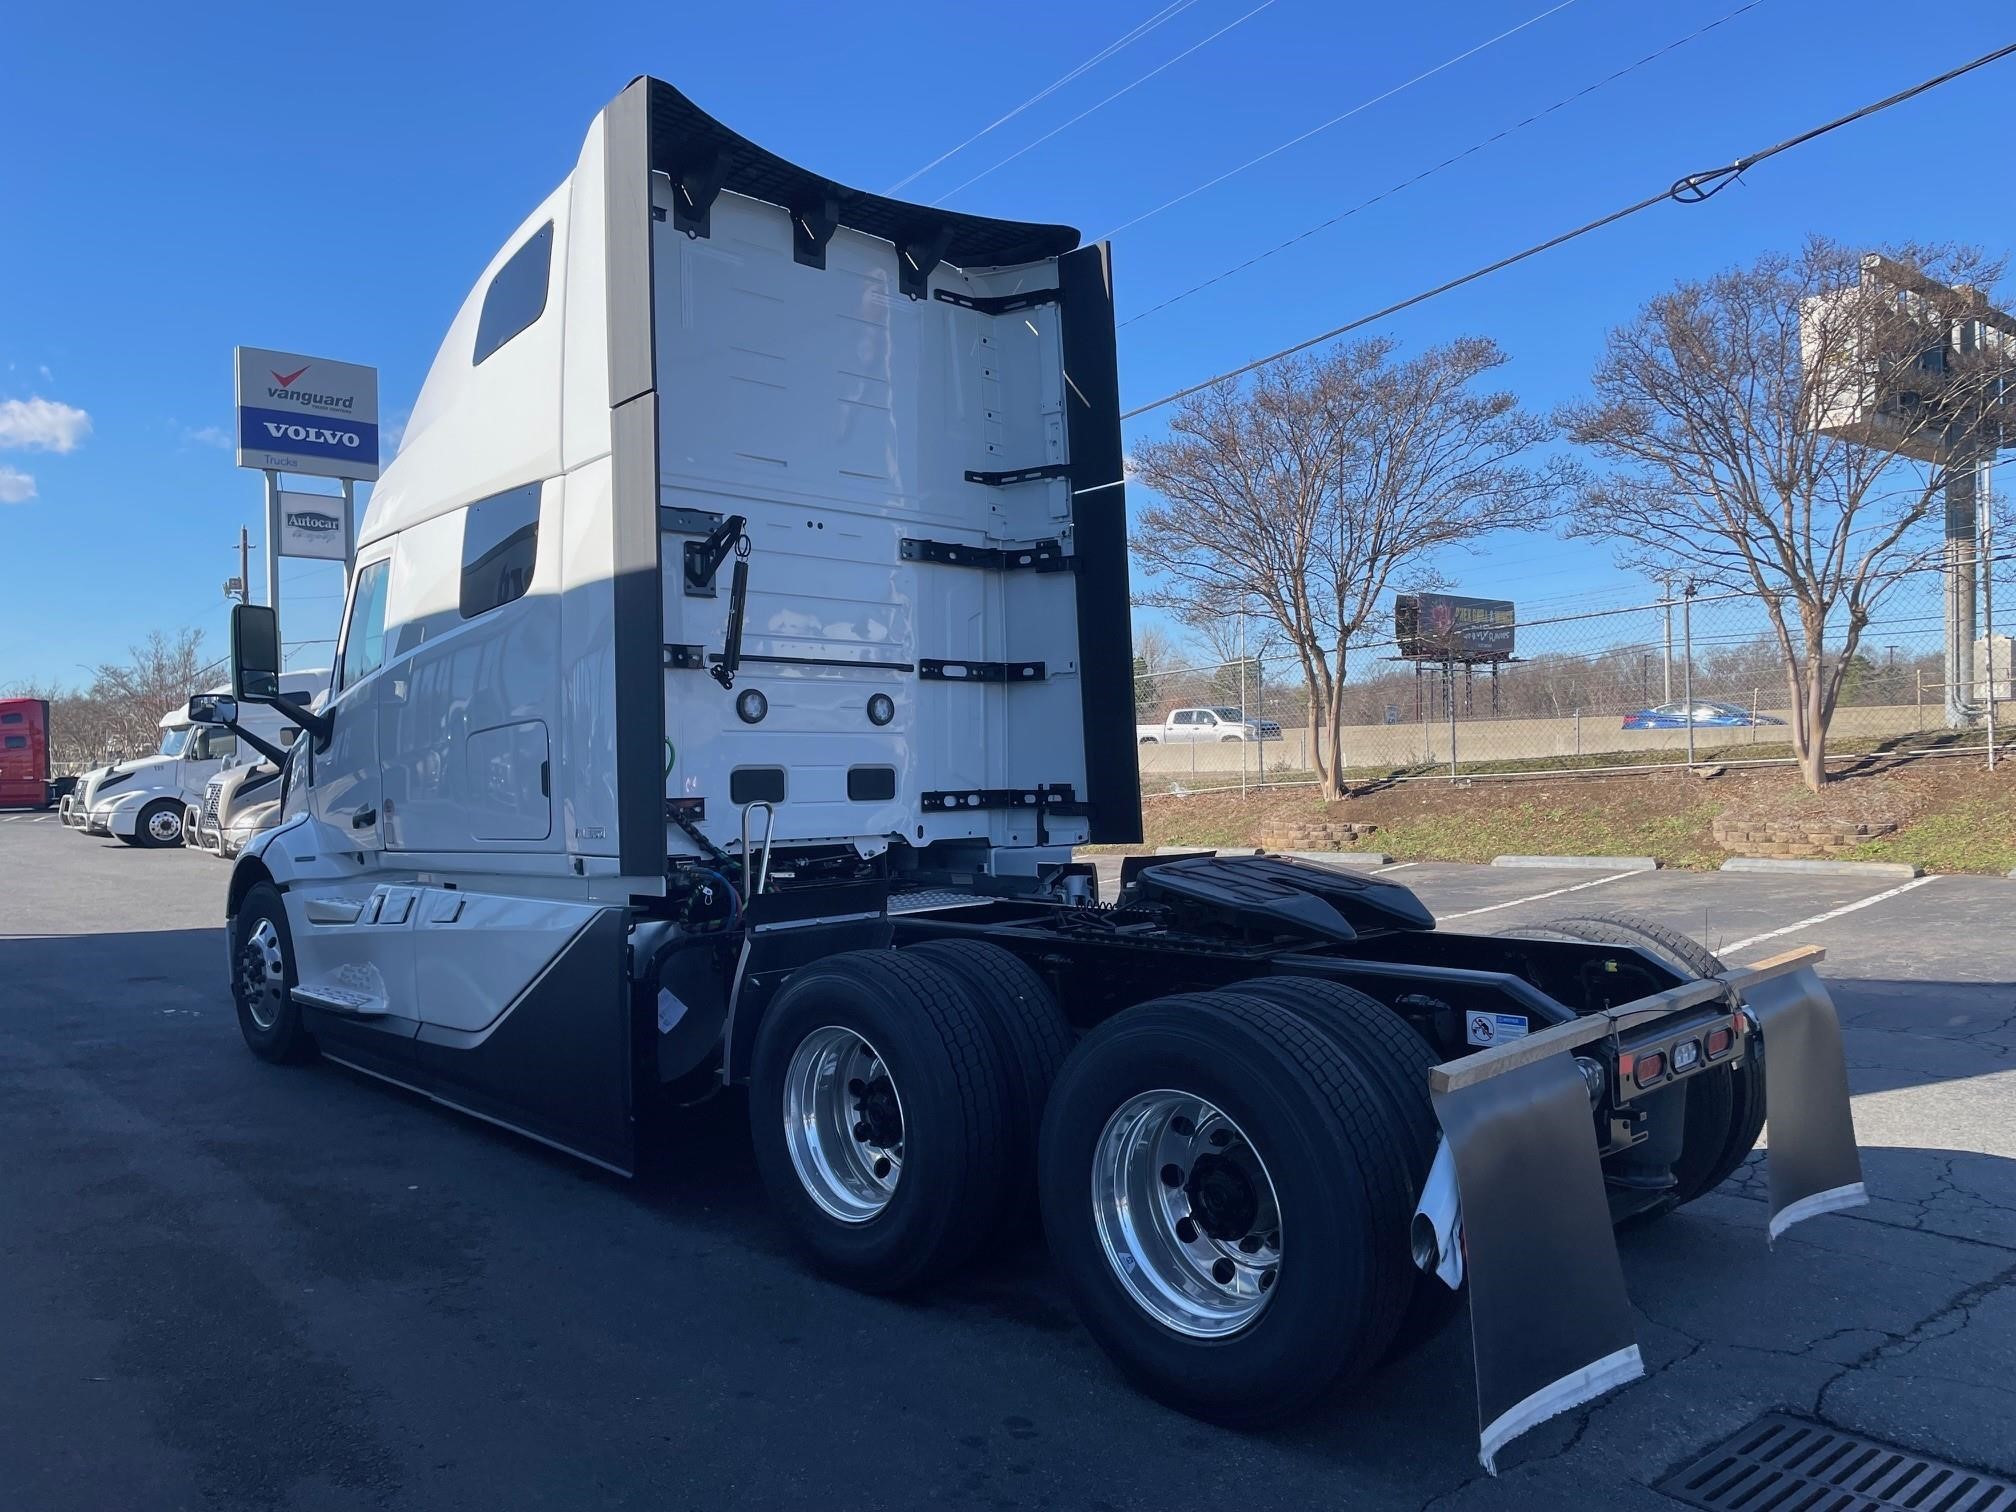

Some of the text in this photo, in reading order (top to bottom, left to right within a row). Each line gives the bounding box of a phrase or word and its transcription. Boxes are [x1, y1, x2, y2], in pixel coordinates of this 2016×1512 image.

[267, 387, 354, 409] vanguard
[263, 422, 360, 448] VOLVO
[264, 454, 298, 467] Trucks
[288, 514, 338, 529] Autocar
